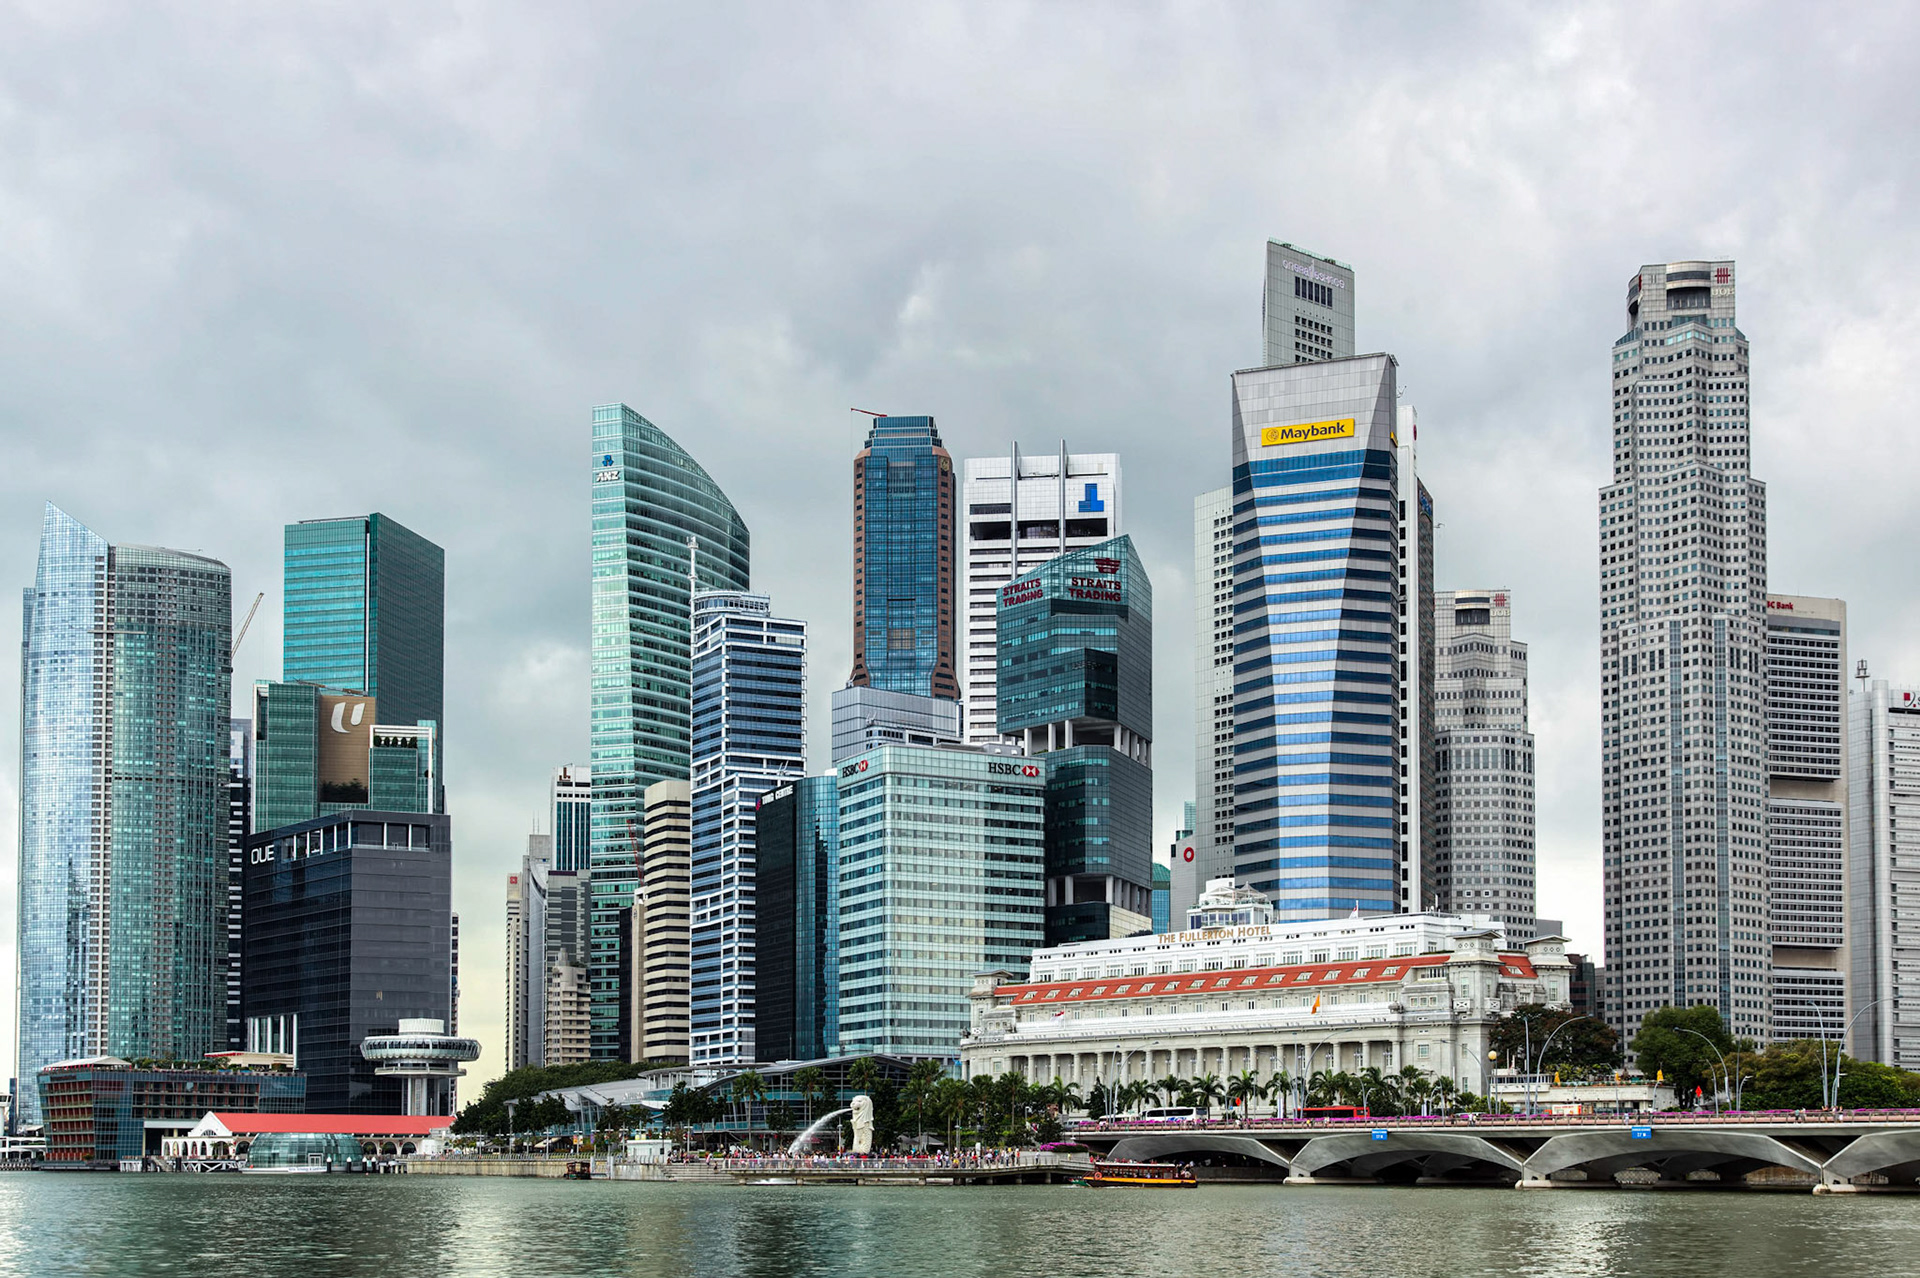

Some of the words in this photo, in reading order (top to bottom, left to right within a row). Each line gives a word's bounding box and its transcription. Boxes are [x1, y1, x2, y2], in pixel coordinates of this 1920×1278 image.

[1280, 422, 1345, 439] Maybank
[596, 470, 620, 482] ANZ
[1002, 578, 1041, 596] STRAITS
[1072, 576, 1121, 590] STRAITS
[1003, 589, 1043, 607] TRADING
[1068, 588, 1121, 602] TRADING
[1776, 601, 1793, 610] Bank
[842, 762, 859, 778] HSBC
[988, 762, 1021, 776] HSBC
[251, 844, 275, 865] OUE
[1157, 933, 1175, 943] THE
[1179, 928, 1234, 942] FULLERTON
[1238, 925, 1271, 937] HOTEL
